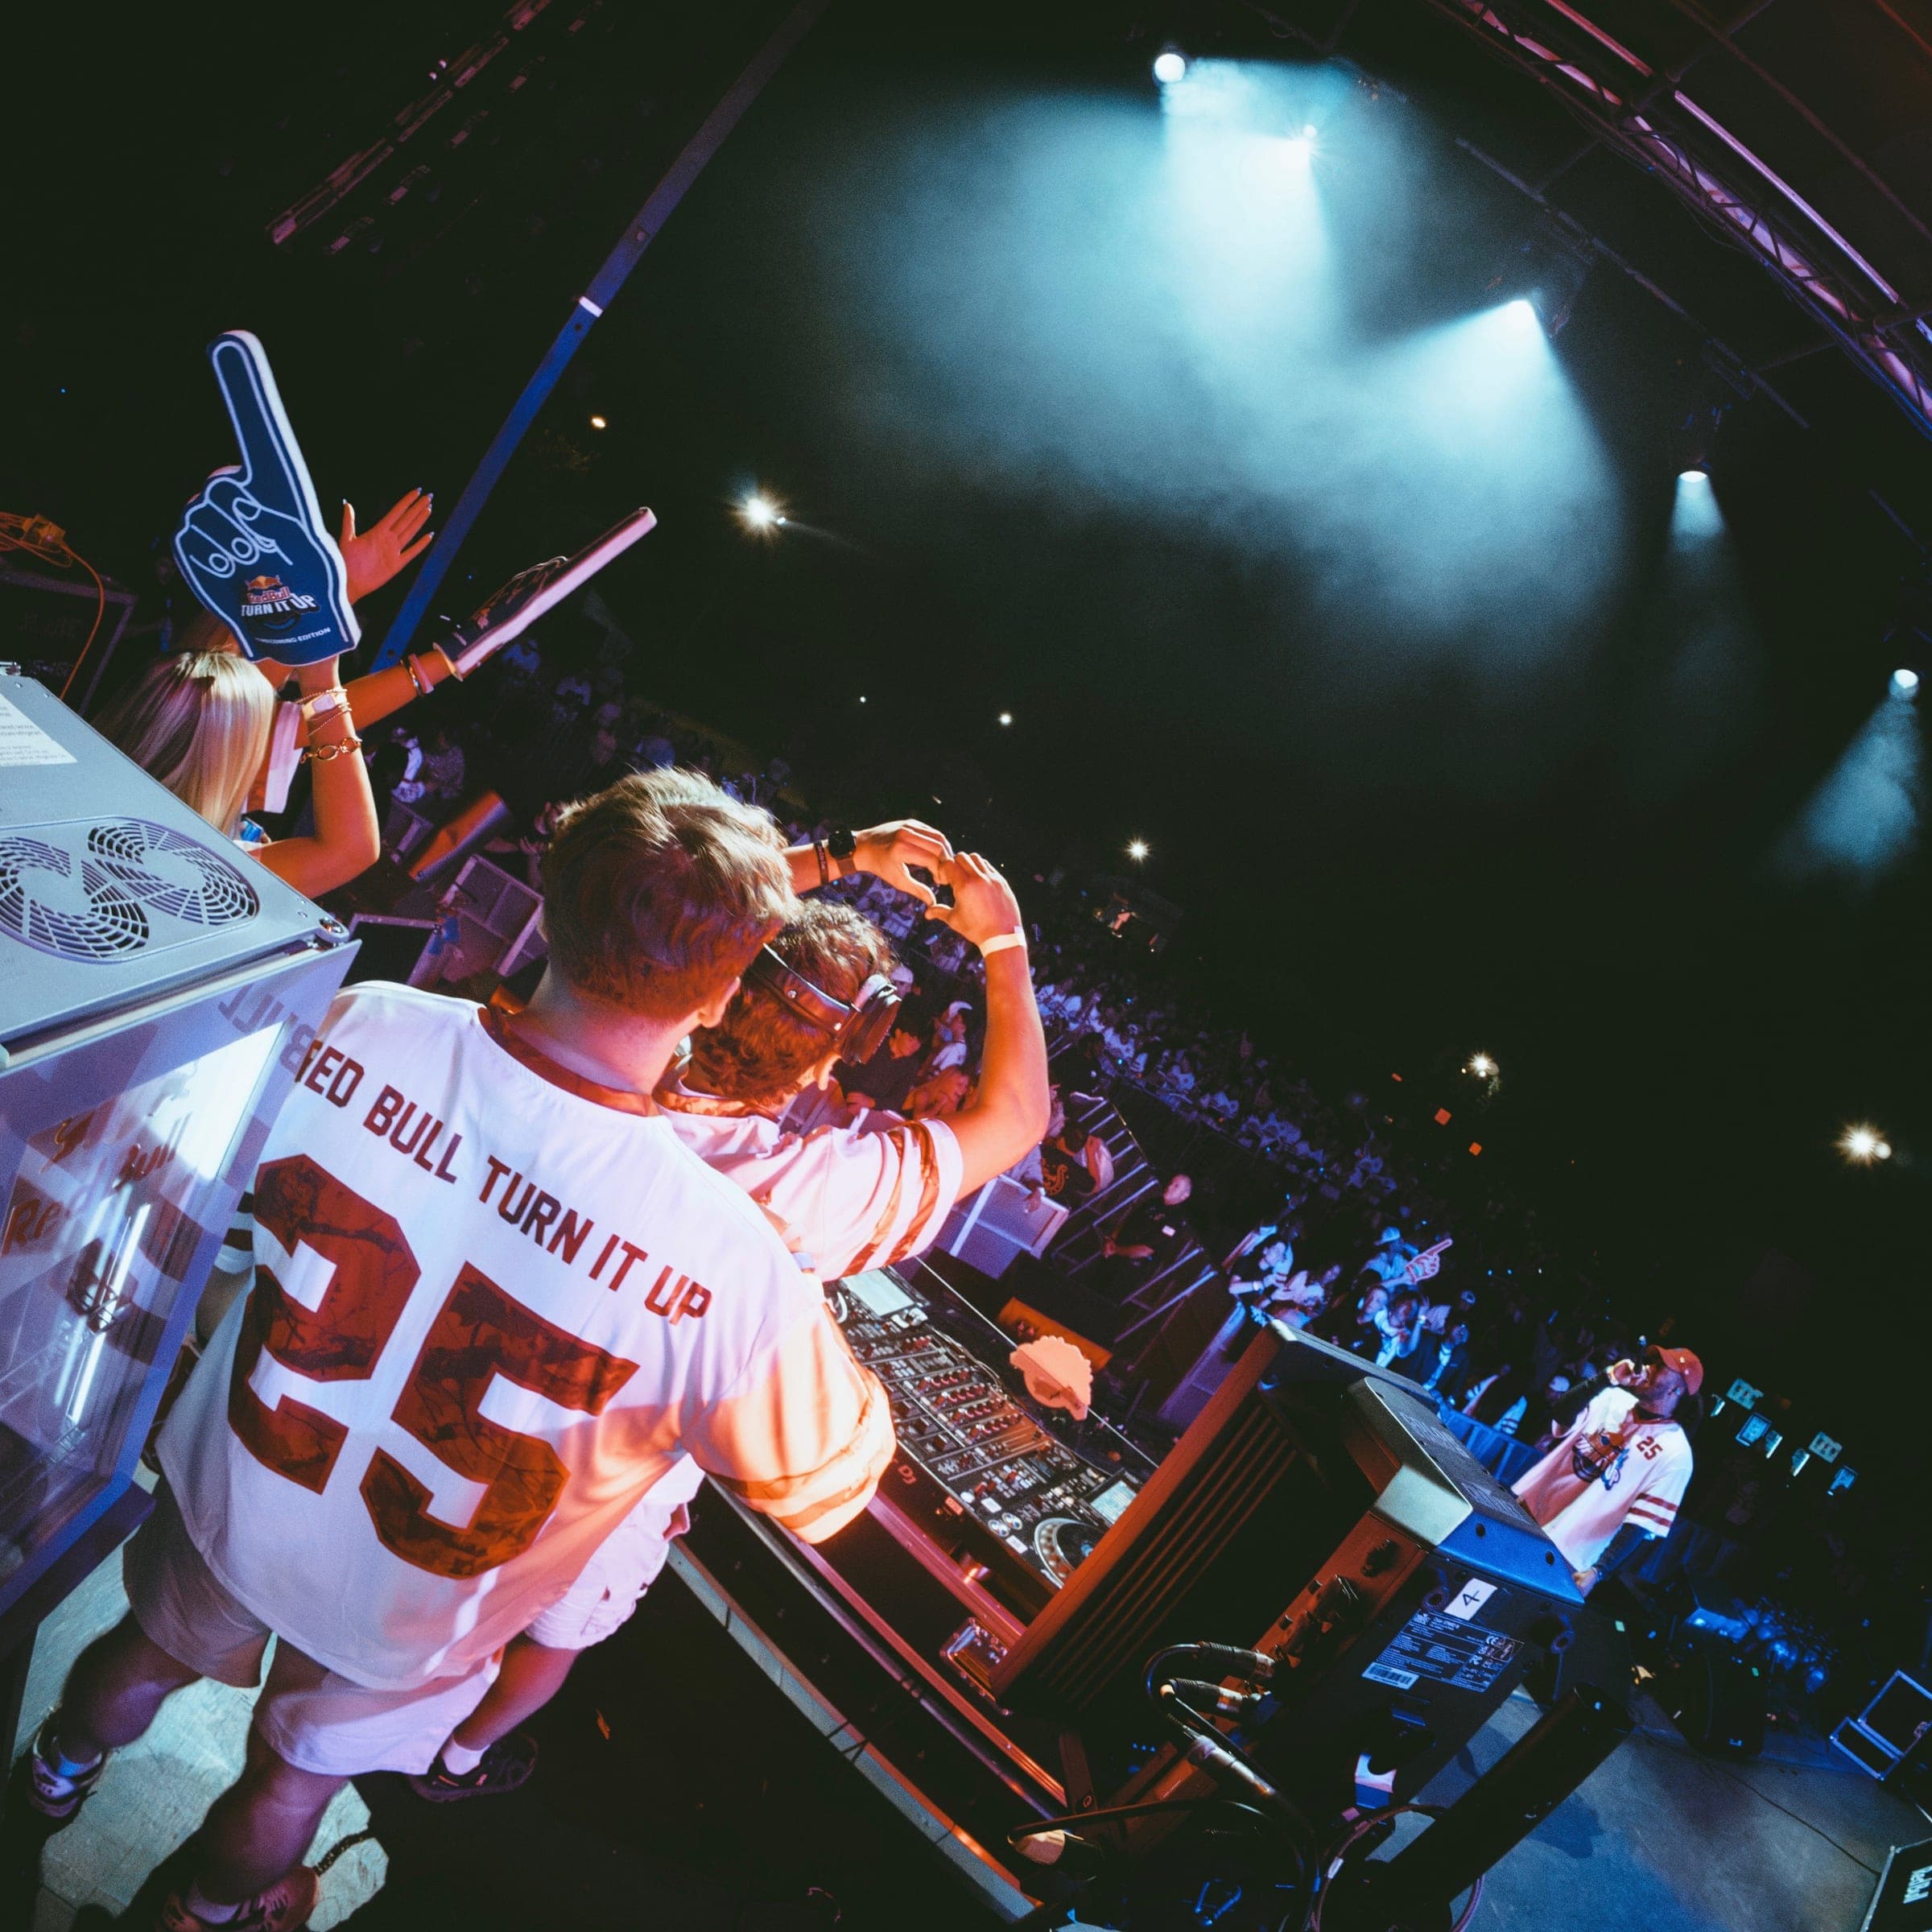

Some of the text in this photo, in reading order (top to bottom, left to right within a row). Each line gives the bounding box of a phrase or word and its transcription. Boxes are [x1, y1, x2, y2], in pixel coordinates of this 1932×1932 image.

[241, 592, 316, 617] TURN IT UP
[298, 627, 331, 642] EDITION
[362, 1084, 463, 1183] BULL
[478, 1155, 594, 1265] TURN
[588, 1234, 648, 1291] IT
[644, 1265, 712, 1325] UP
[228, 1154, 641, 1579] 25
[1637, 1436, 1662, 1460] 25
[1462, 1590, 1480, 1607] 4
